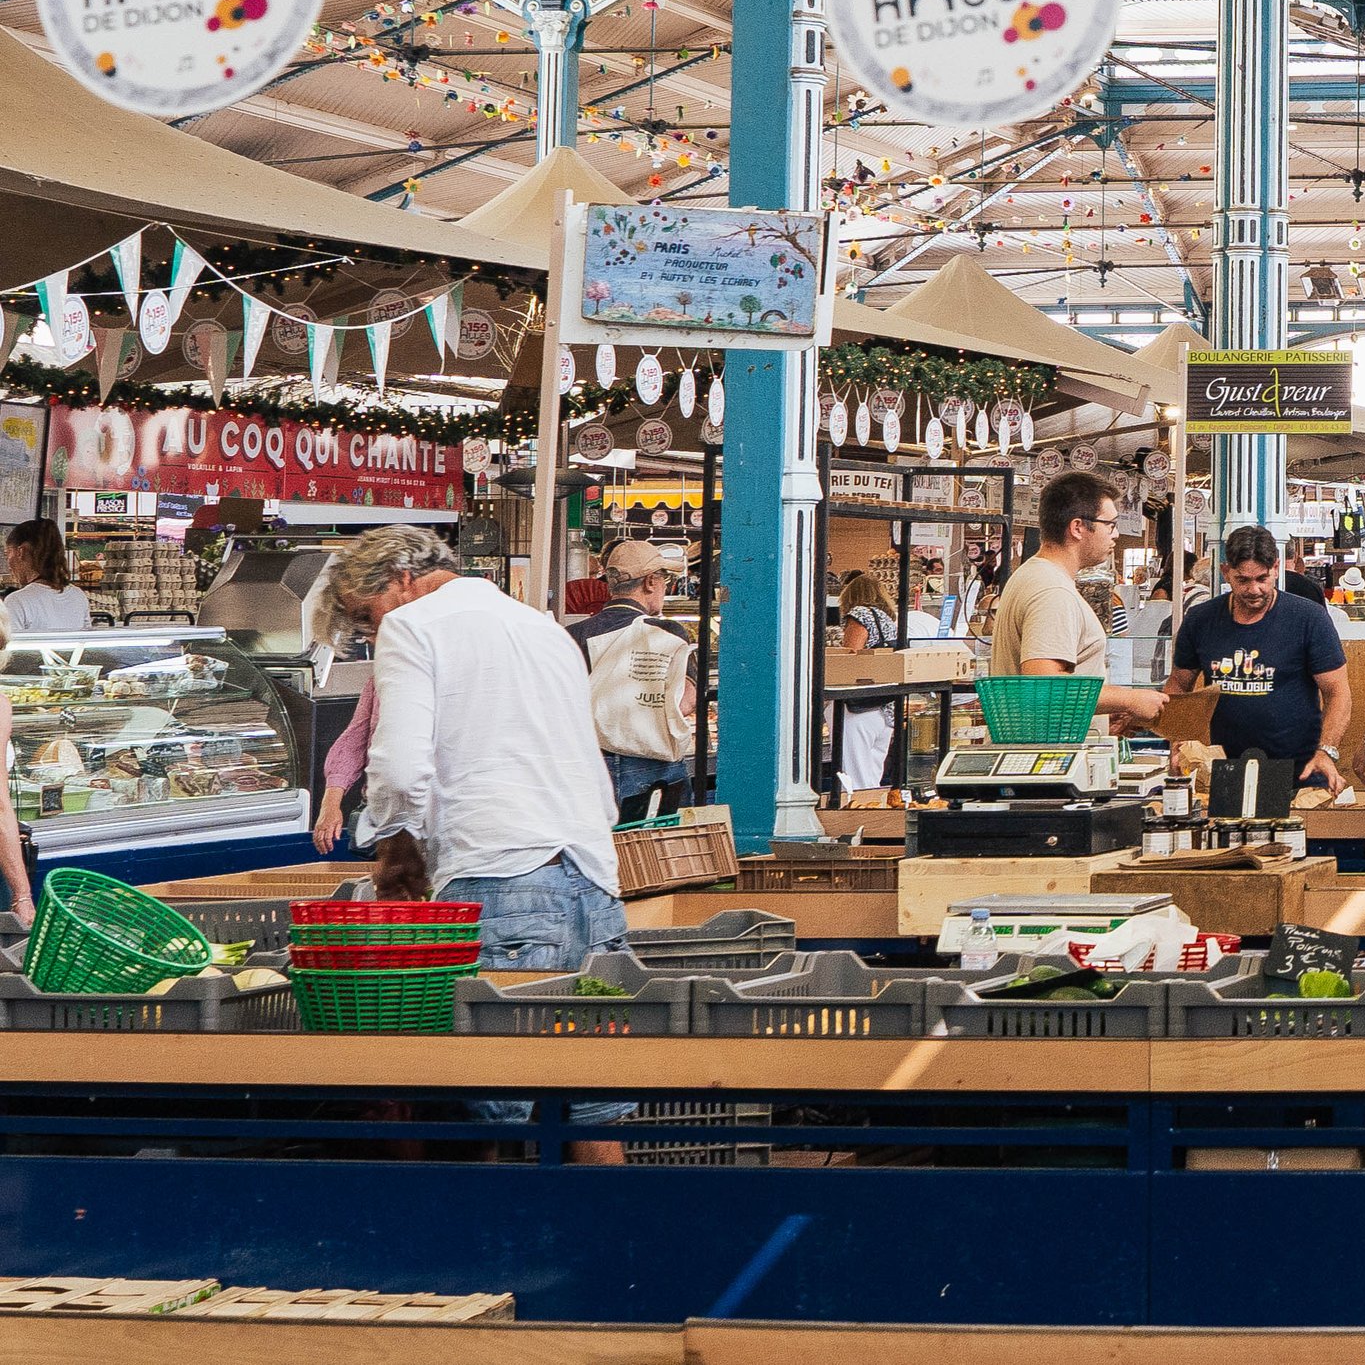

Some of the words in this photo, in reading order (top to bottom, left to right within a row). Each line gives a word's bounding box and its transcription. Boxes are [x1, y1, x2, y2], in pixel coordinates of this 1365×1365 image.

[83, 11, 116, 34] DE
[124, 1, 203, 28] DIJON
[874, 26, 907, 49] DE
[917, 13, 999, 43] DIJON
[664, 259, 729, 271] PRODUCTEUR
[660, 271, 694, 283] RUFFEY
[700, 275, 717, 284] LES
[1190, 352, 1273, 362] BOULANGERIE
[1286, 352, 1349, 362] PATISSERIE
[1312, 408, 1347, 420] Boulanger
[162, 417, 207, 455] AU
[221, 421, 286, 470] COQ
[295, 427, 339, 471] QUI
[350, 433, 447, 474] CHANTE
[187, 462, 216, 472] VOLAILLE
[854, 475, 869, 486] DU
[97, 499, 125, 507] BLASON
